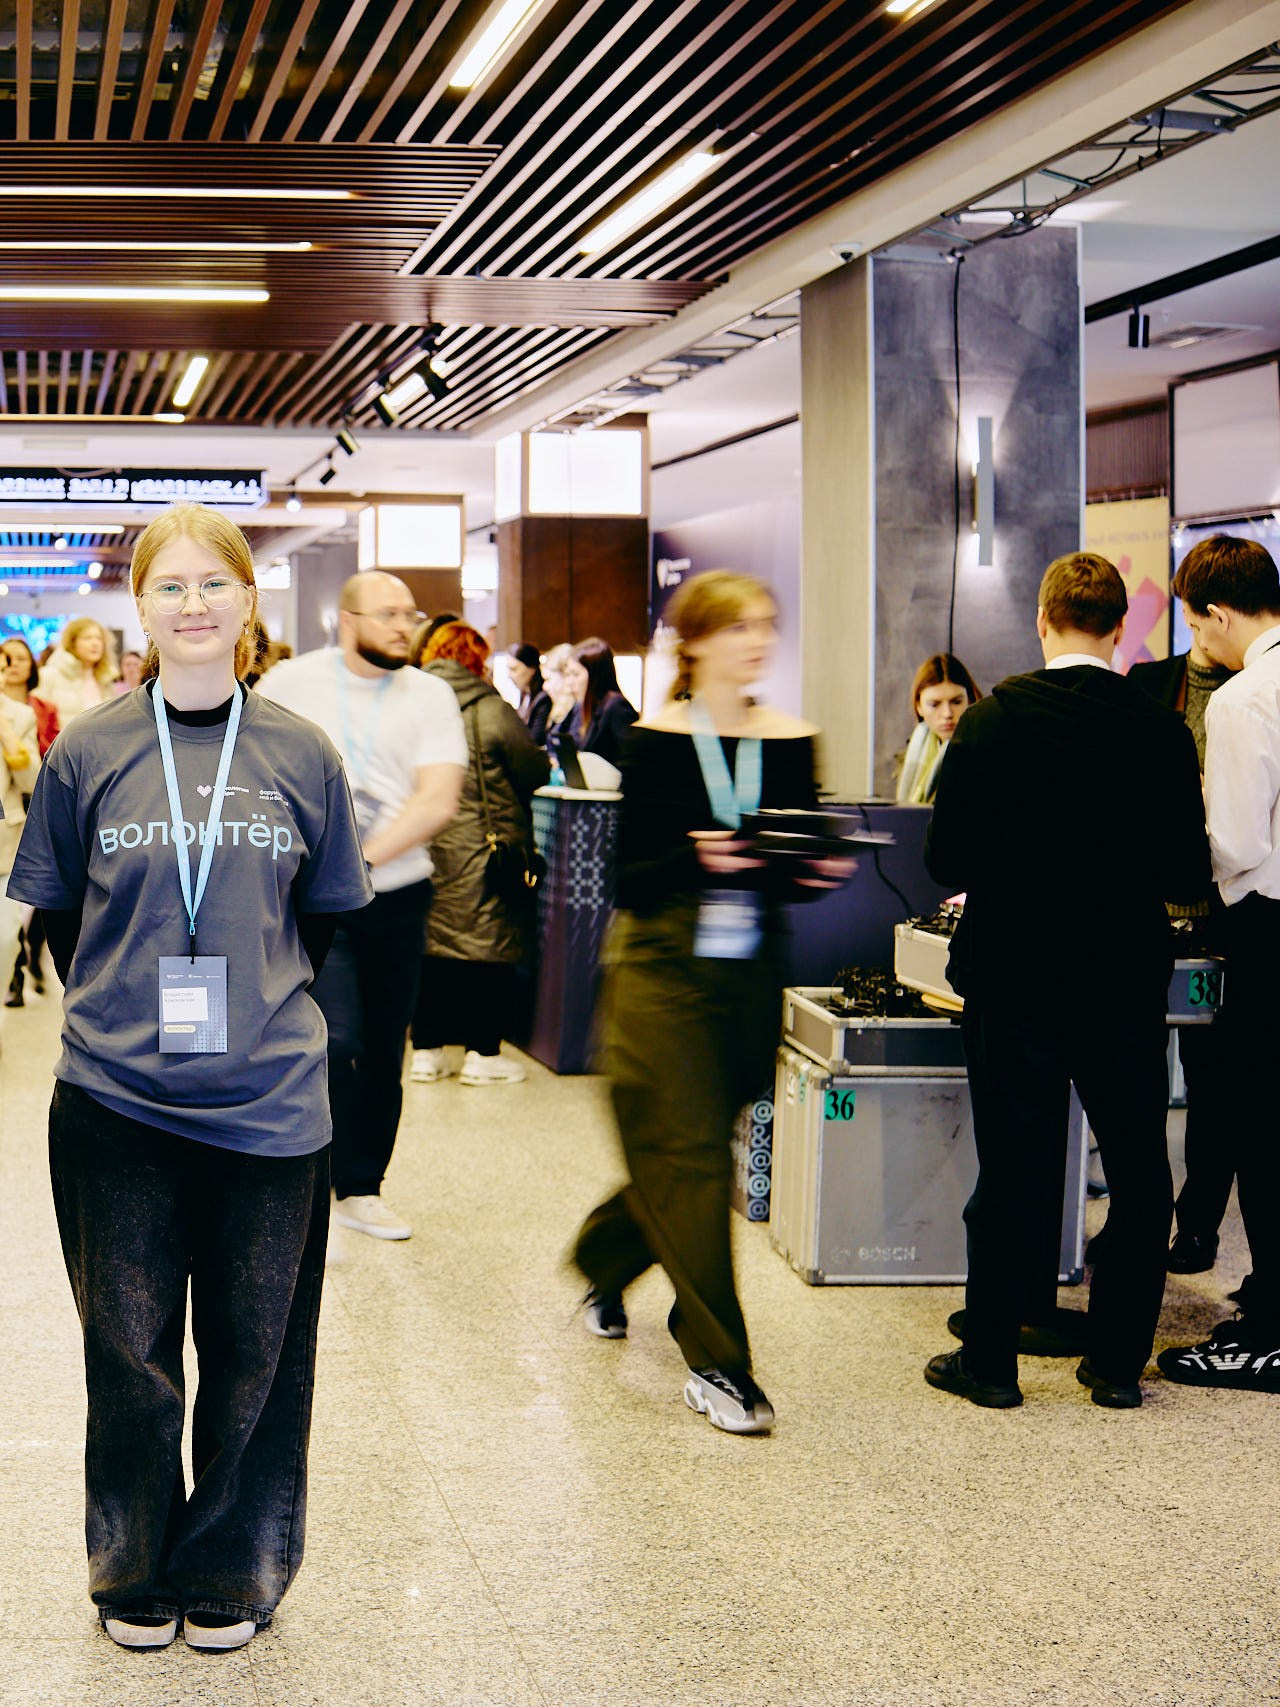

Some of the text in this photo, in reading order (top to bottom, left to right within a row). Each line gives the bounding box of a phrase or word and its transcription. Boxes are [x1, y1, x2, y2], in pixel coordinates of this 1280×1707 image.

[99, 813, 294, 861] волонтёр
[1189, 971, 1220, 1006] 38
[825, 1090, 855, 1121] 36
[858, 1246, 917, 1262] BOSCH
